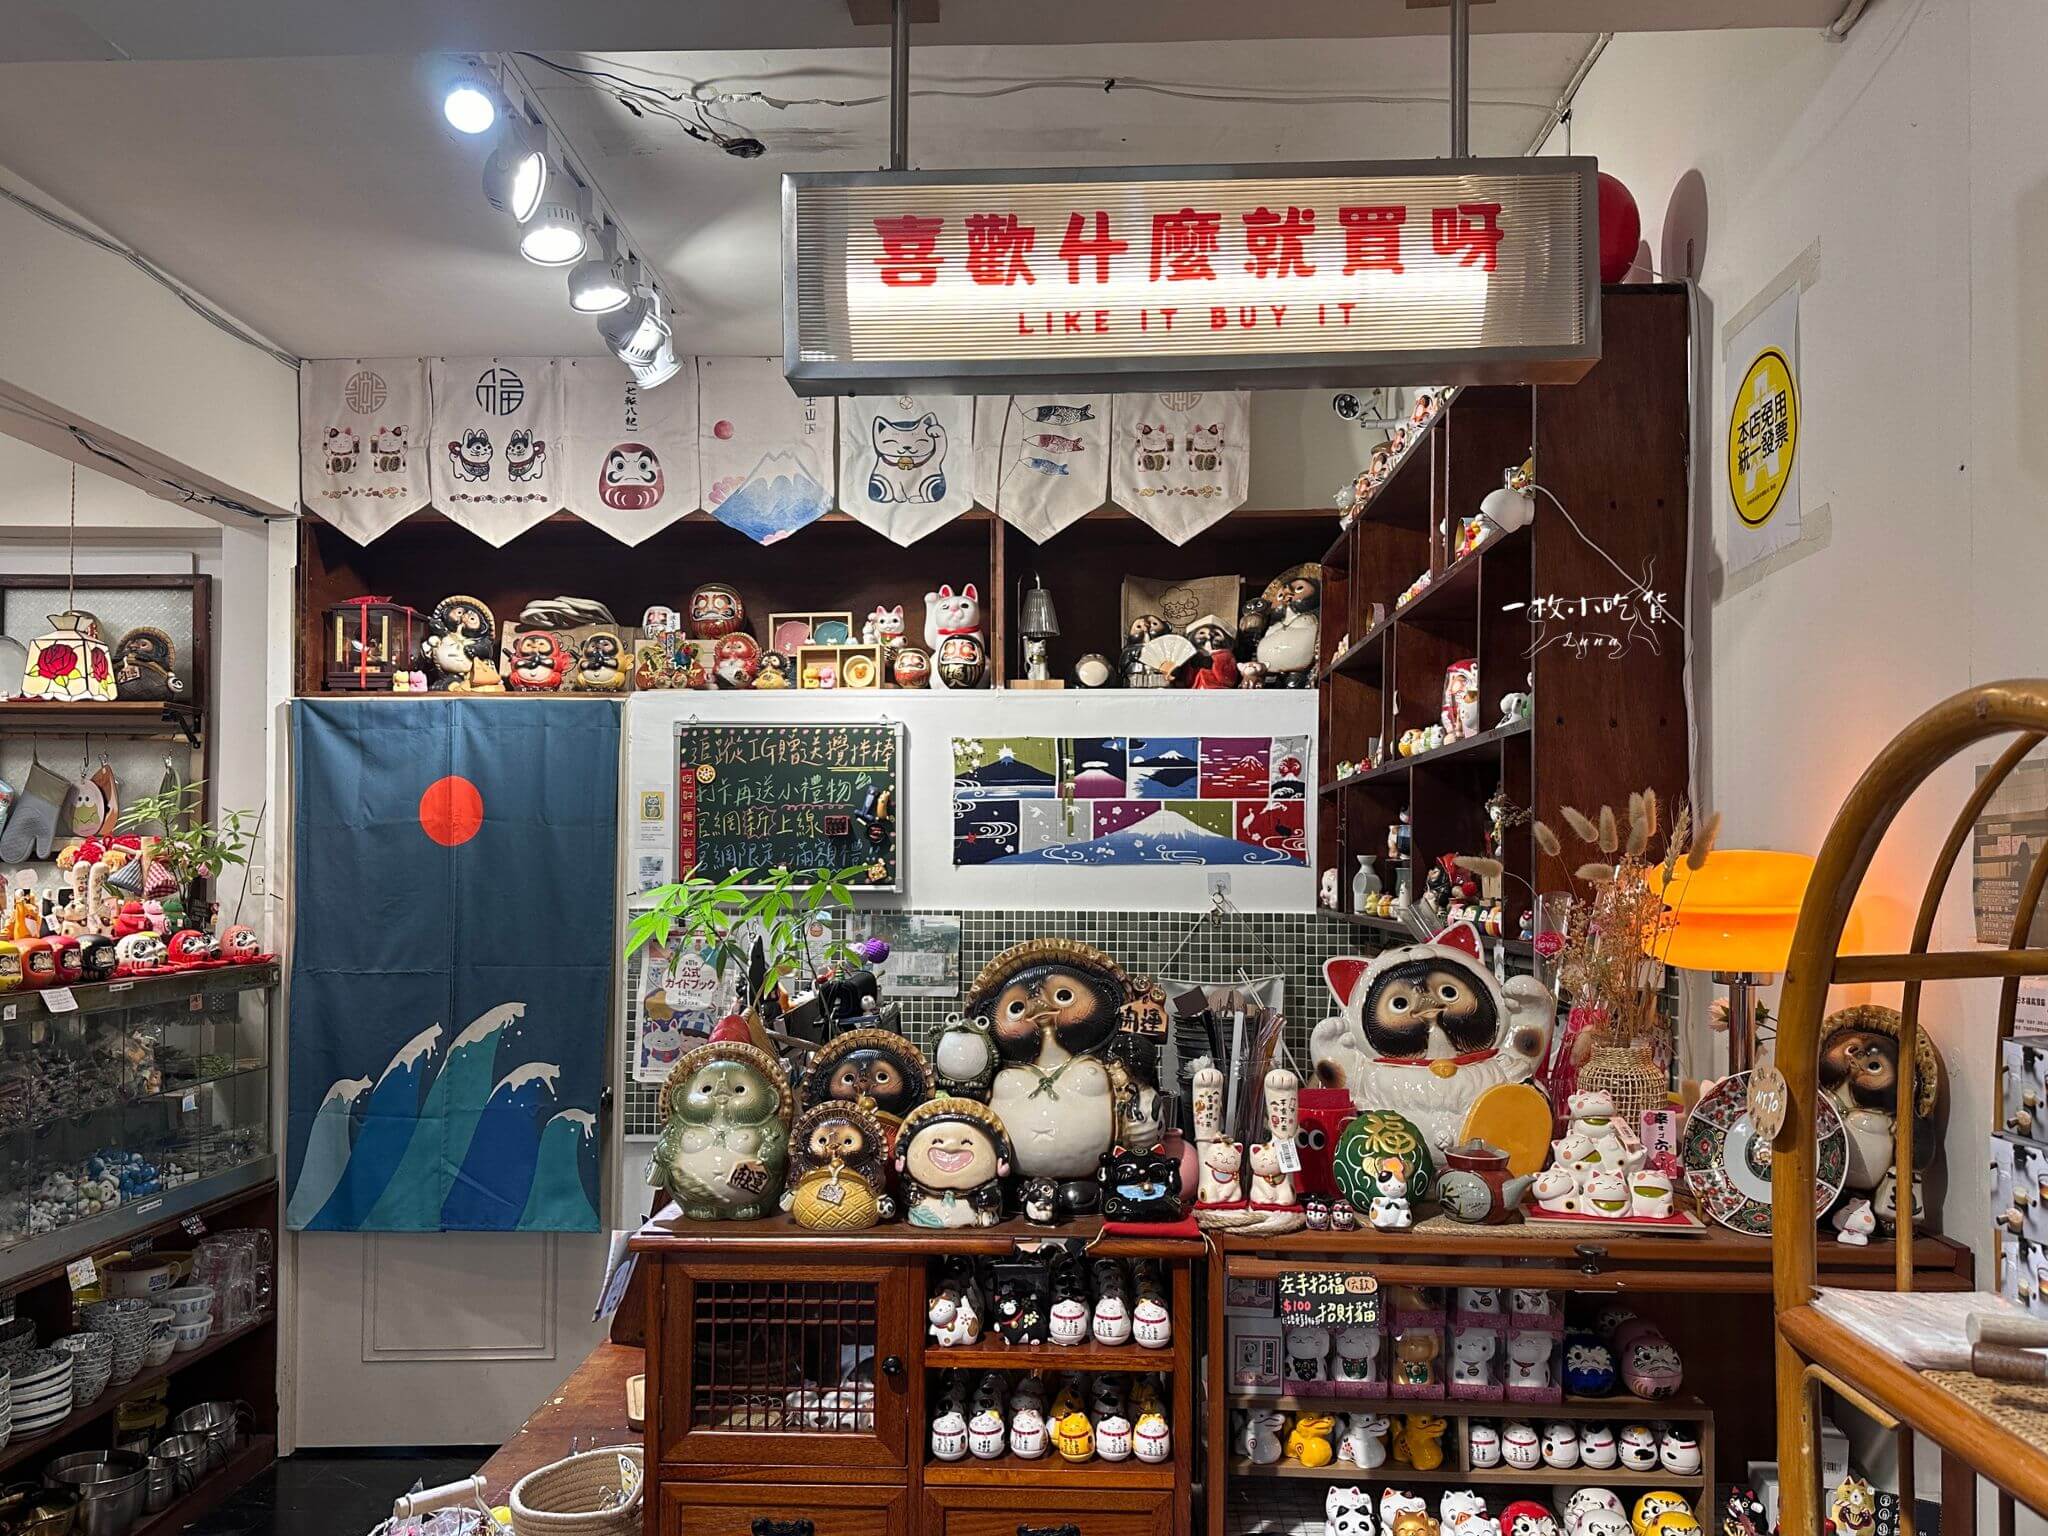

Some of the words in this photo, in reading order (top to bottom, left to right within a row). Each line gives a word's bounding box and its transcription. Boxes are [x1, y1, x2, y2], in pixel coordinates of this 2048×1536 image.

[872, 204, 1504, 288] 喜歡什麼就買呀
[1018, 310, 1110, 335] LIKE
[1141, 308, 1178, 332] IT
[1210, 306, 1284, 330] BUY
[1319, 303, 1357, 326] IT
[1737, 389, 1787, 445] 本店免用
[1738, 417, 1789, 475] 統一發票
[697, 773, 851, 806] 打卡再送小禮物
[665, 978, 717, 991] ガイドブック
[682, 966, 701, 978] 公式
[1363, 1114, 1416, 1154] 福
[1280, 1272, 1346, 1297] 左手招福
[1282, 1297, 1312, 1314] $100
[1316, 1301, 1376, 1325] 招財貓
